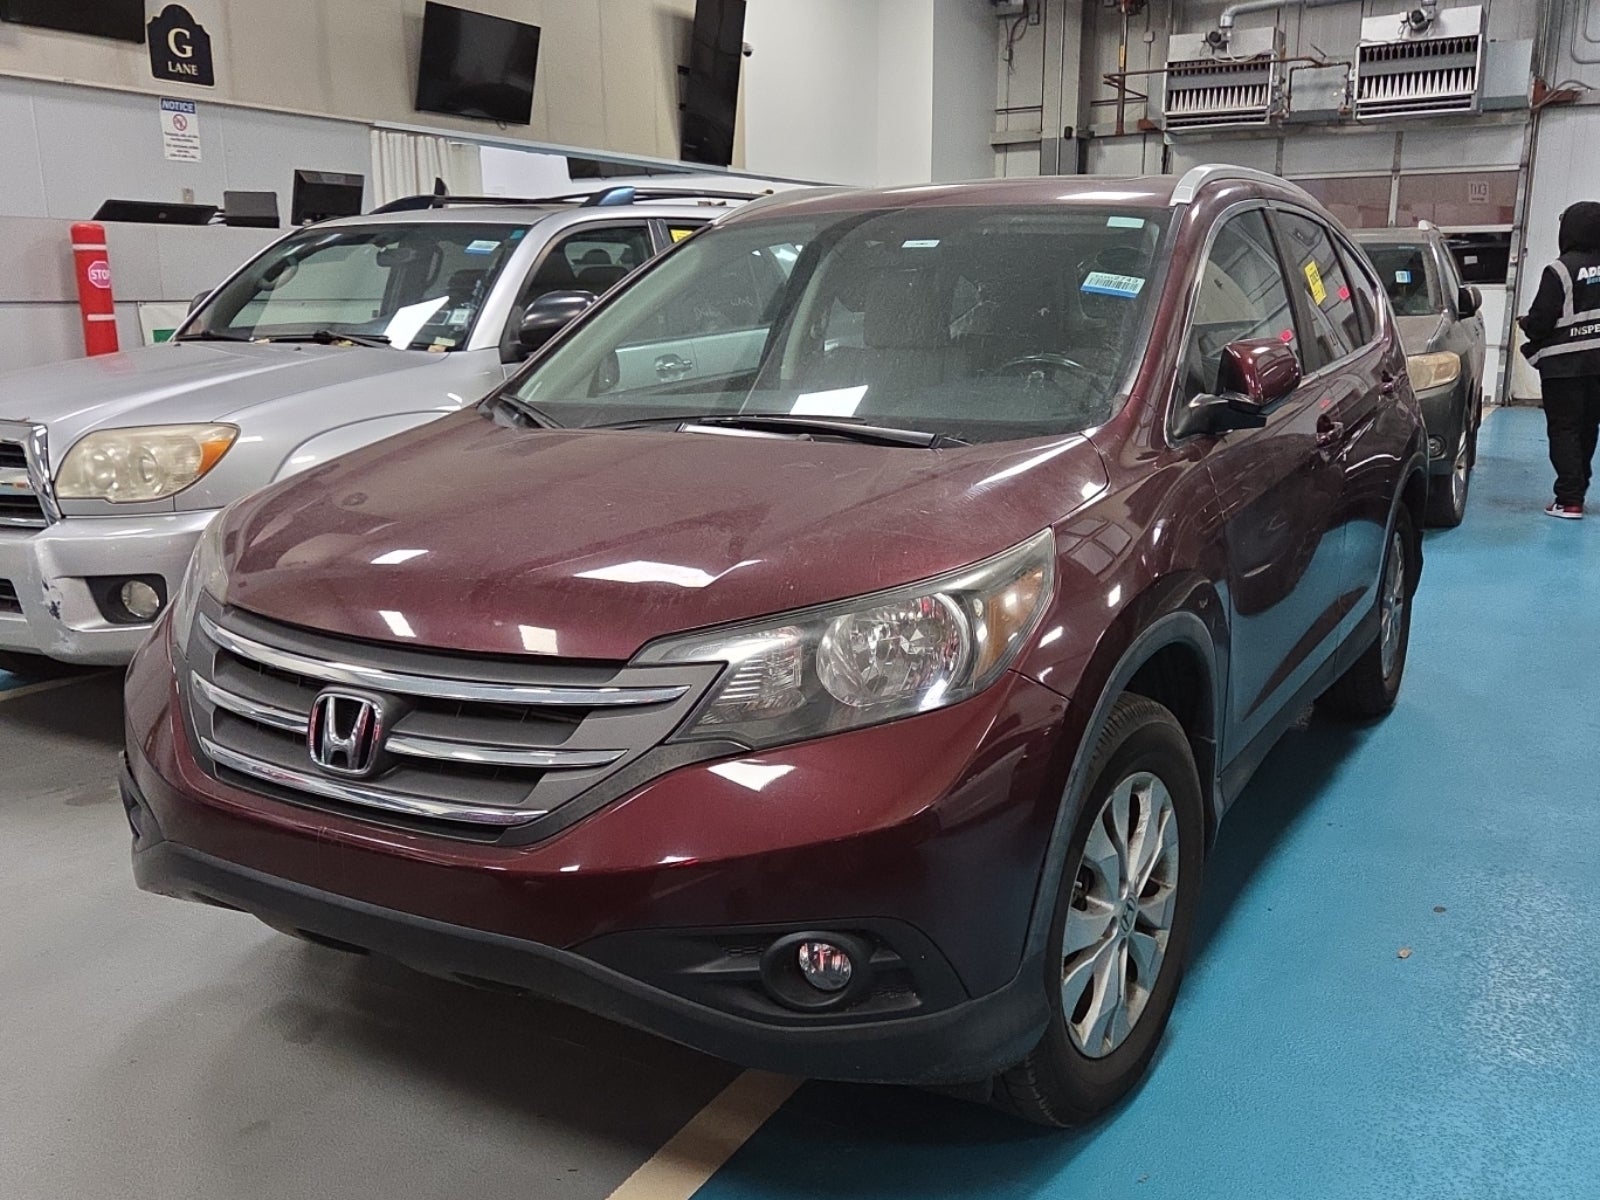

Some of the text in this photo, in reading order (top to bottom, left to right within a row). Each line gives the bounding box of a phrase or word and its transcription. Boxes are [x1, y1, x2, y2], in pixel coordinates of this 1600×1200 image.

[168, 28, 193, 58] G
[168, 61, 198, 76] LANE
[162, 100, 194, 112] NOTICE
[90, 269, 110, 280] STO
